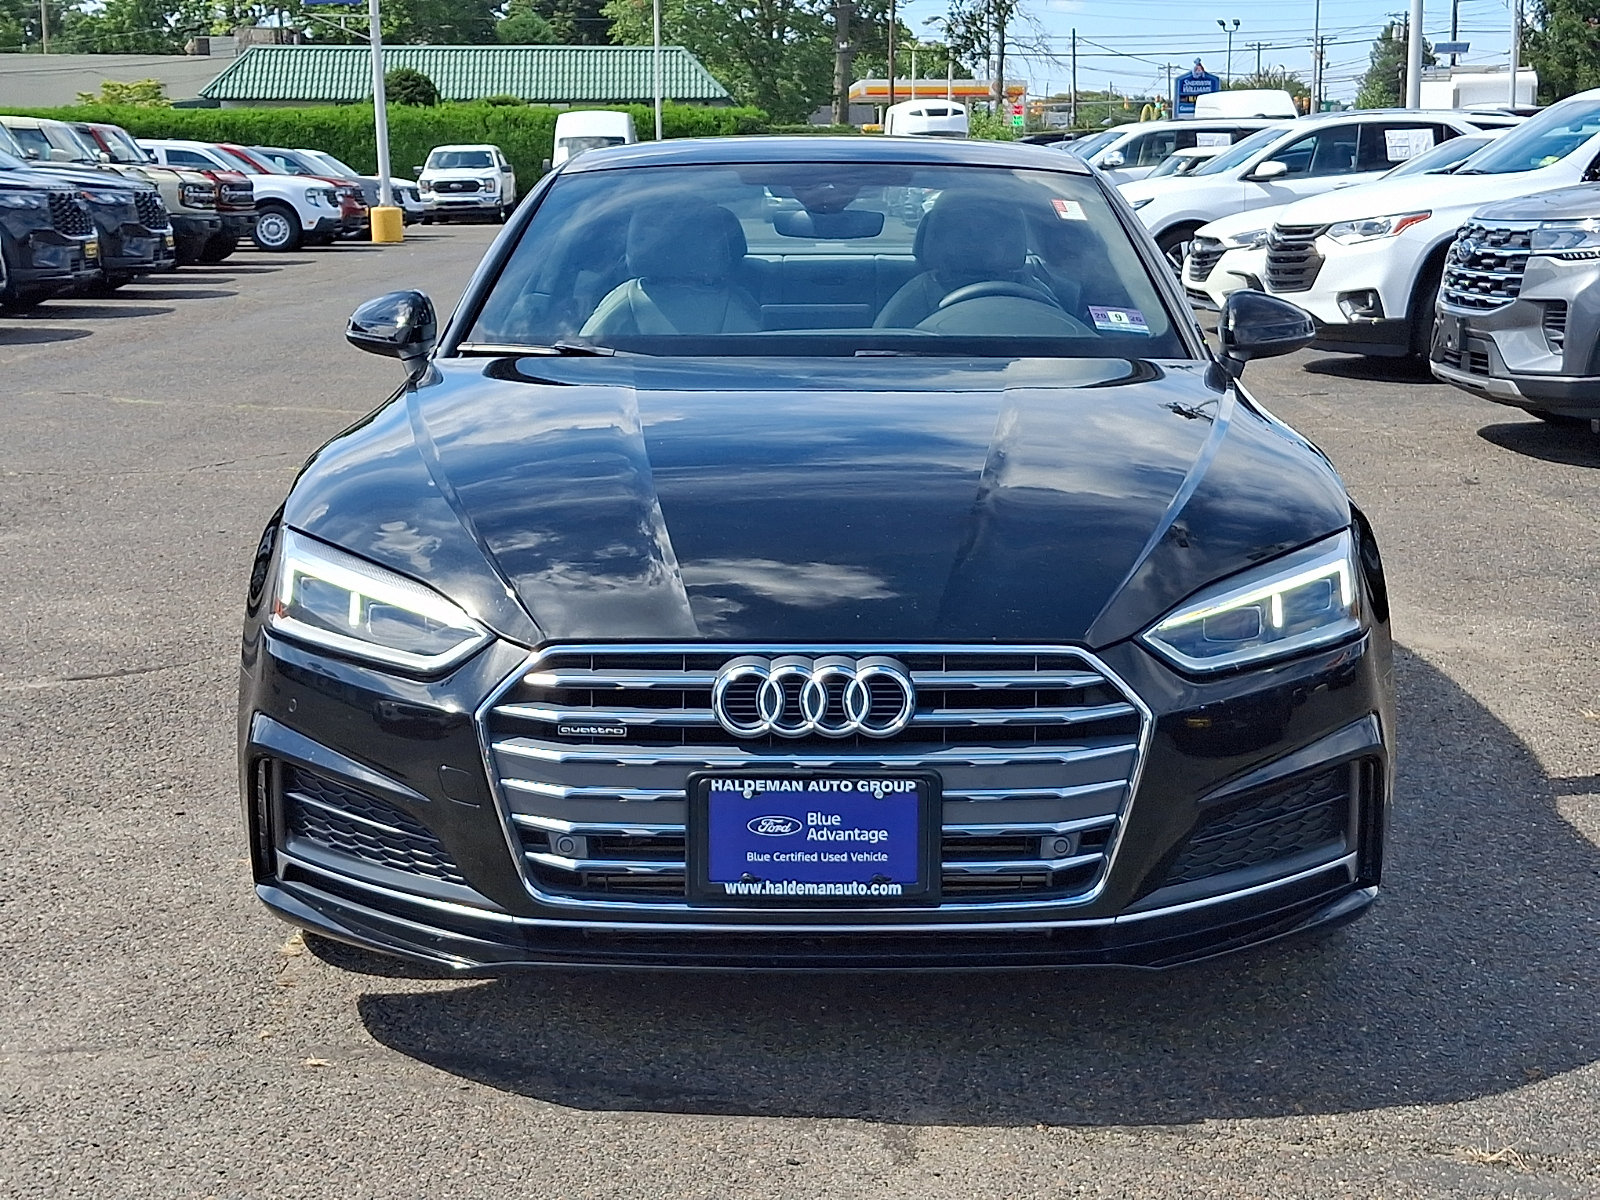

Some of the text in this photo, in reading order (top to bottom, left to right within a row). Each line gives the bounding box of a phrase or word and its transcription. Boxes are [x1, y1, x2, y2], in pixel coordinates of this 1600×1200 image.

[1114, 313, 1123, 322] 9
[560, 726, 624, 735] quattro
[710, 779, 917, 793] HALDEMAN AUTO GROUP
[807, 811, 842, 826] Blue
[757, 818, 793, 835] Ford
[806, 827, 889, 844] Advantage
[746, 851, 889, 862] Blue Certified Used Vehicle
[724, 880, 903, 896] www.haldemanauto.com
